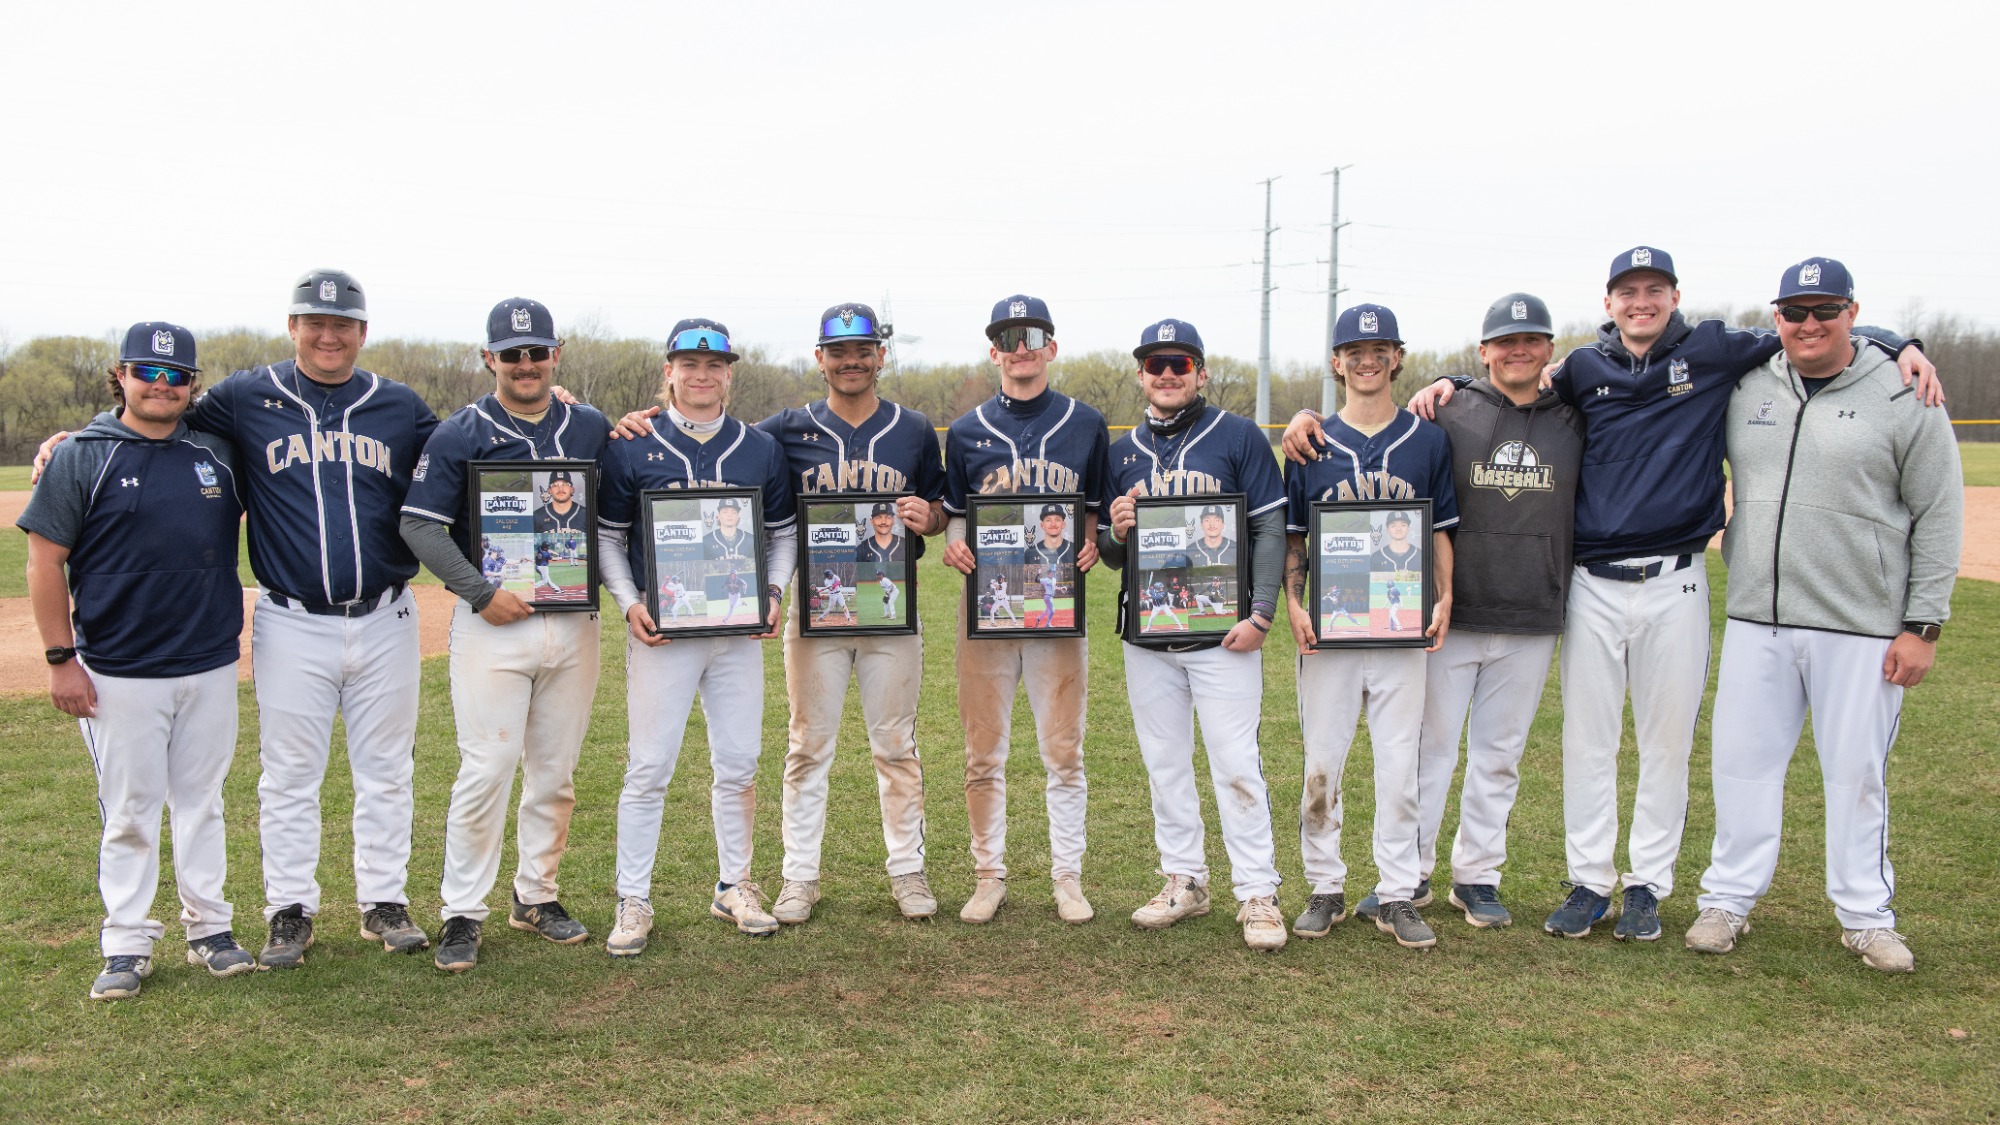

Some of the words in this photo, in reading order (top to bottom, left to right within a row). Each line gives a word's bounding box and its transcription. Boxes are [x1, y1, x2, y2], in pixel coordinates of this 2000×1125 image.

[1667, 383, 1693, 393] CANTON
[266, 430, 392, 478] CANTON
[980, 458, 1079, 494] CANTON
[1473, 464, 1551, 488] BASEBALL
[485, 500, 526, 510] CANTON
[656, 528, 696, 539] CANTON
[811, 531, 850, 541] CANTON
[980, 533, 1018, 543] CANTON
[1141, 535, 1179, 545] CANTON
[1325, 540, 1364, 550] CANTON
